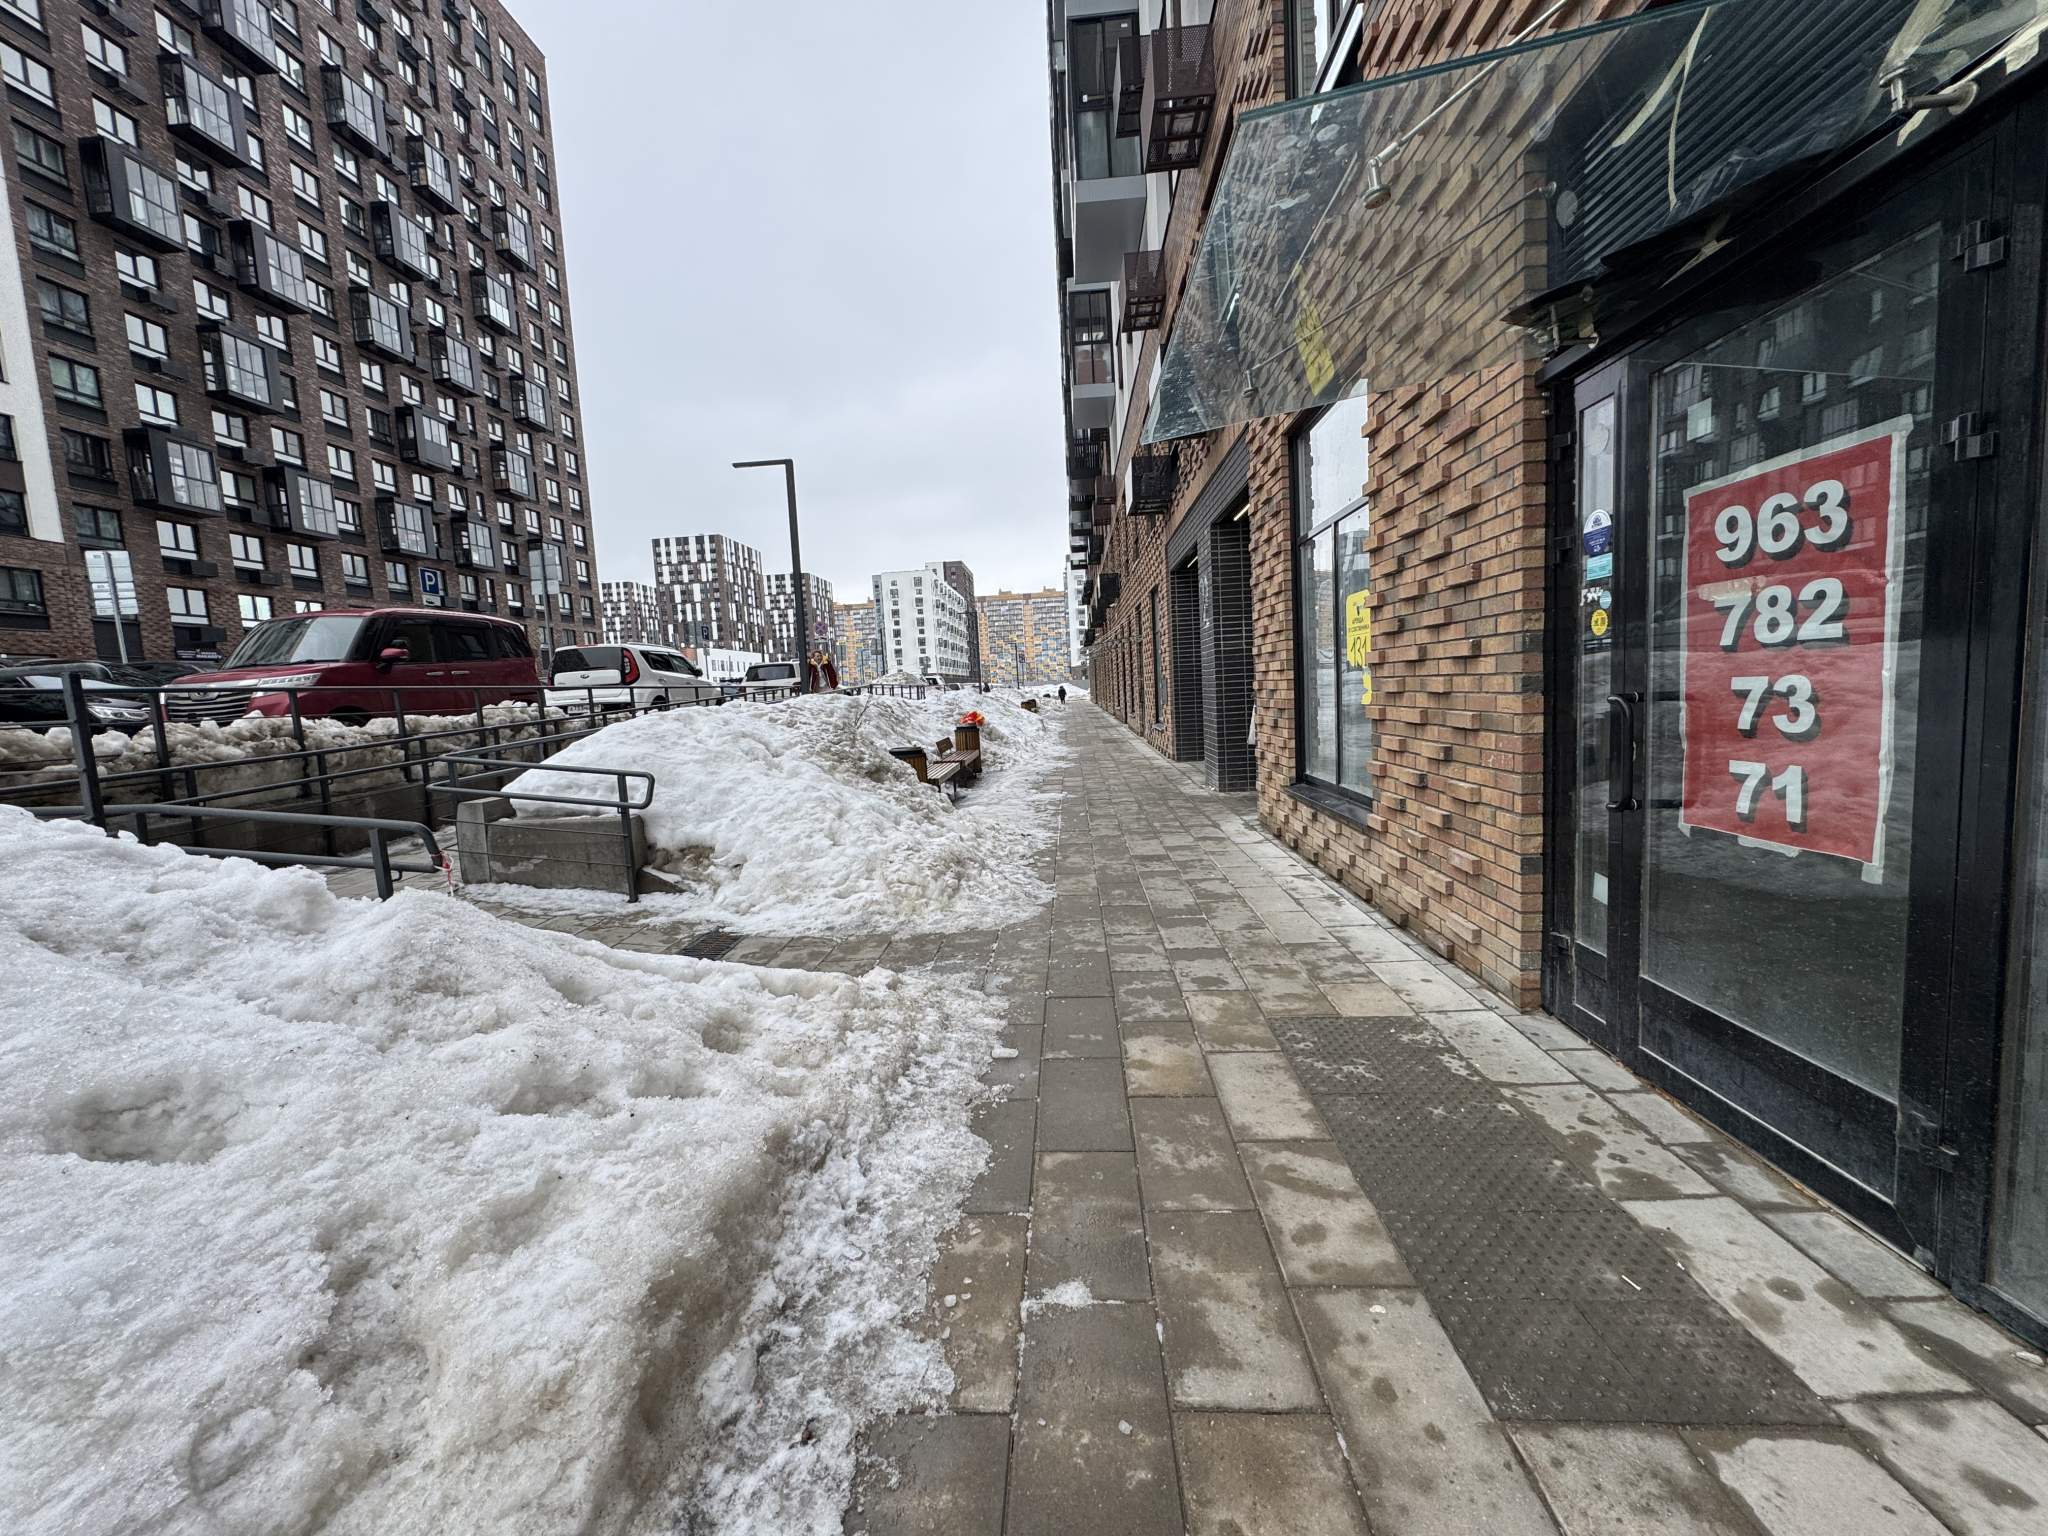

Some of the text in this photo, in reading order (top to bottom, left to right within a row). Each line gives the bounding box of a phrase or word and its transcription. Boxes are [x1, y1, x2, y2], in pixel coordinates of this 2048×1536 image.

[1714, 479, 1850, 563] 963
[424, 571, 436, 591] P
[1713, 577, 1844, 648] 782
[1731, 674, 1817, 735] 73
[1729, 759, 1804, 825] 71
